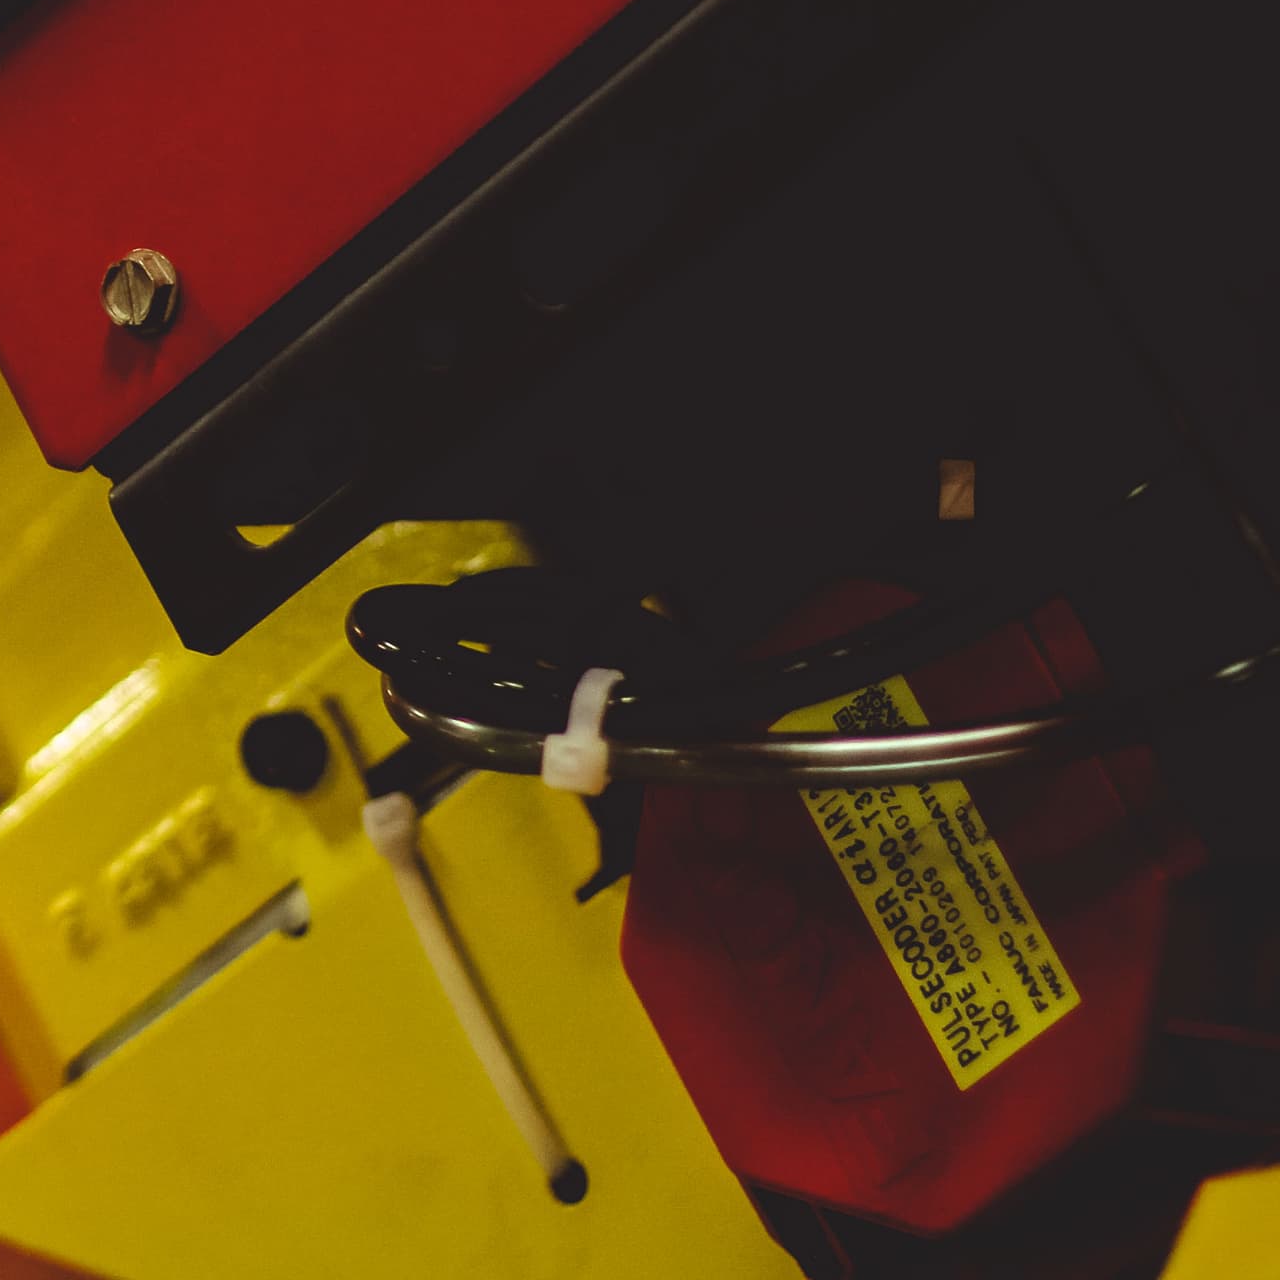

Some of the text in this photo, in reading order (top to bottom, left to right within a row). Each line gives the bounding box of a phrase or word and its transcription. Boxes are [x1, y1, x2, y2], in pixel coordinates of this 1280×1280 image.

[876, 783, 924, 857] 14072
[922, 866, 982, 964] 0010209
[997, 882, 1028, 925] JAPAN
[874, 887, 982, 1068] PULSECODER
[998, 931, 1049, 1014] FANUC
[1025, 933, 1040, 951] IN
[1038, 961, 1066, 1000] MADE
[955, 982, 999, 1051] TYPE
